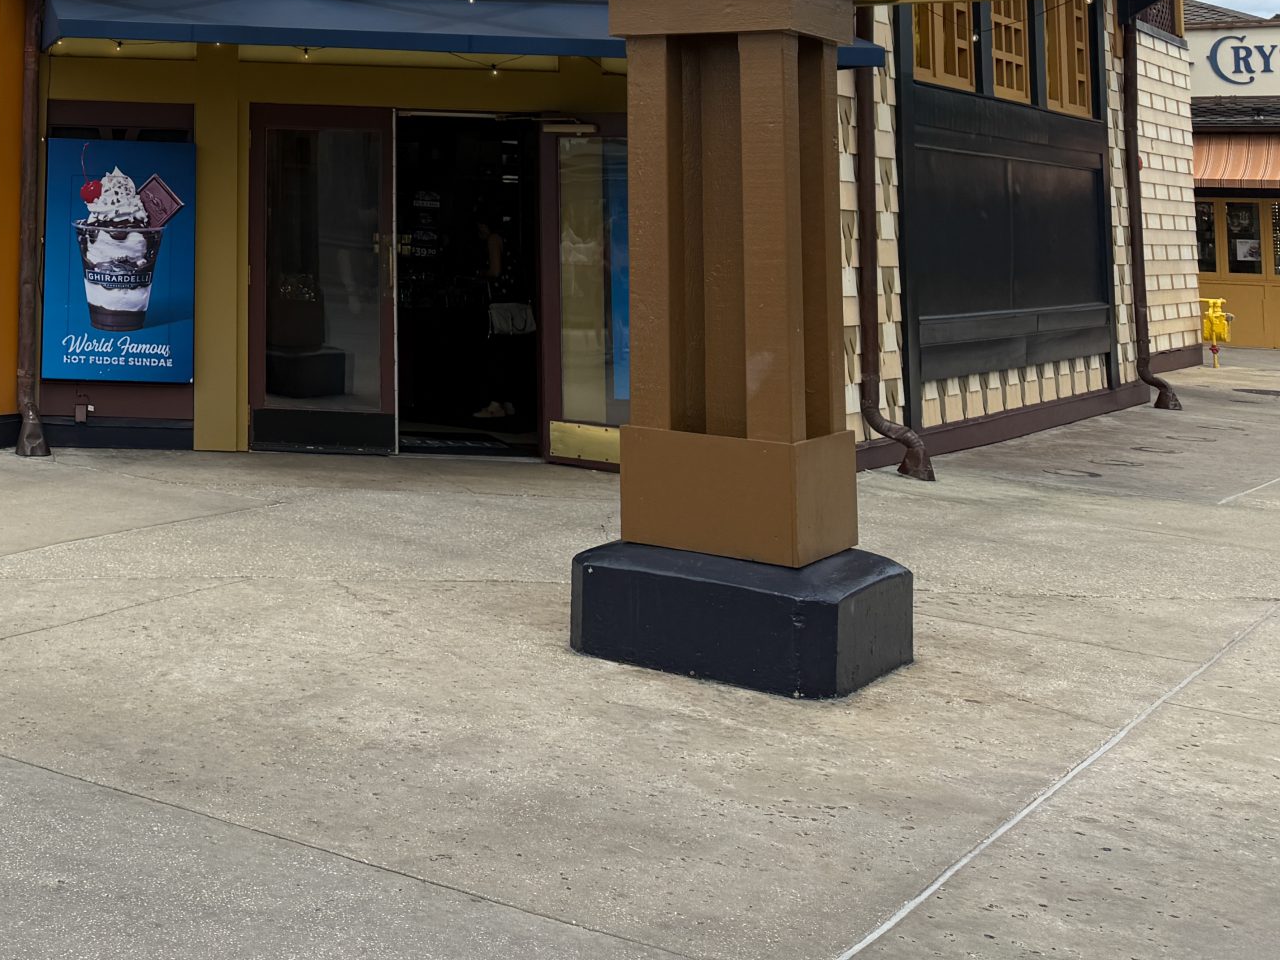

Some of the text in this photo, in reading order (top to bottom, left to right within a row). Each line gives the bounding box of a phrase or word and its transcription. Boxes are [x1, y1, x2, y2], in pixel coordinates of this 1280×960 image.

[1206, 35, 1280, 85] CRY
[88, 273, 149, 283] GHIRARDELLI
[61, 333, 171, 357] World Famous
[63, 355, 173, 367] HOT FUDGE SUNDAE
